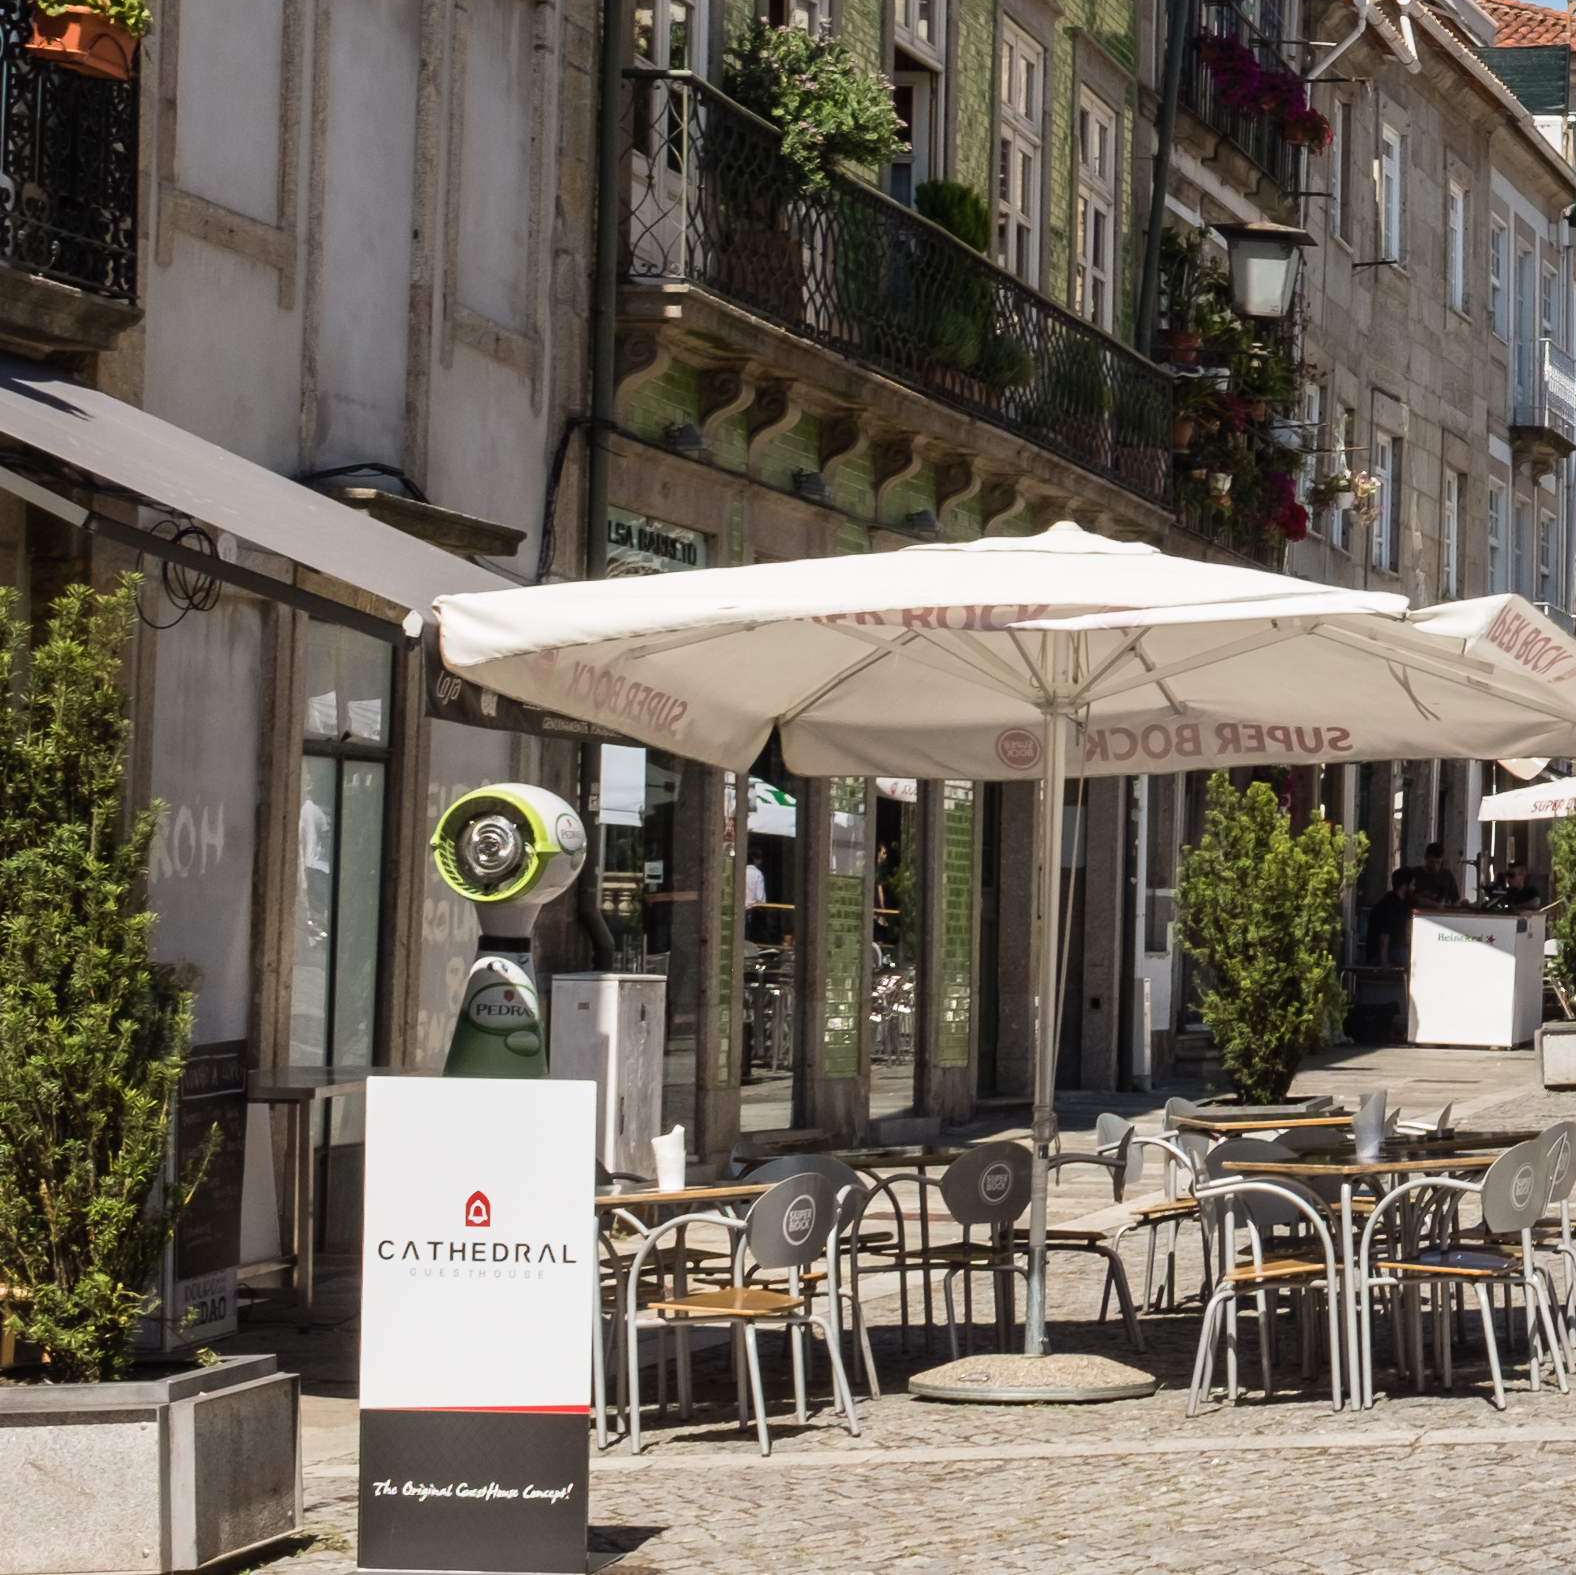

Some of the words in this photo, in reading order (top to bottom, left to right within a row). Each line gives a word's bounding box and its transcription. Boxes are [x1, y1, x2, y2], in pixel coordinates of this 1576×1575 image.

[476, 1002, 536, 1018] PEDRAS
[789, 1208, 812, 1221] SUPER
[378, 1239, 577, 1264] CATHEDRAL
[409, 1267, 545, 1280] GUESTHOUSE
[372, 1478, 398, 1497] The
[402, 1480, 454, 1502] Original
[522, 1482, 575, 1505] Concept!
